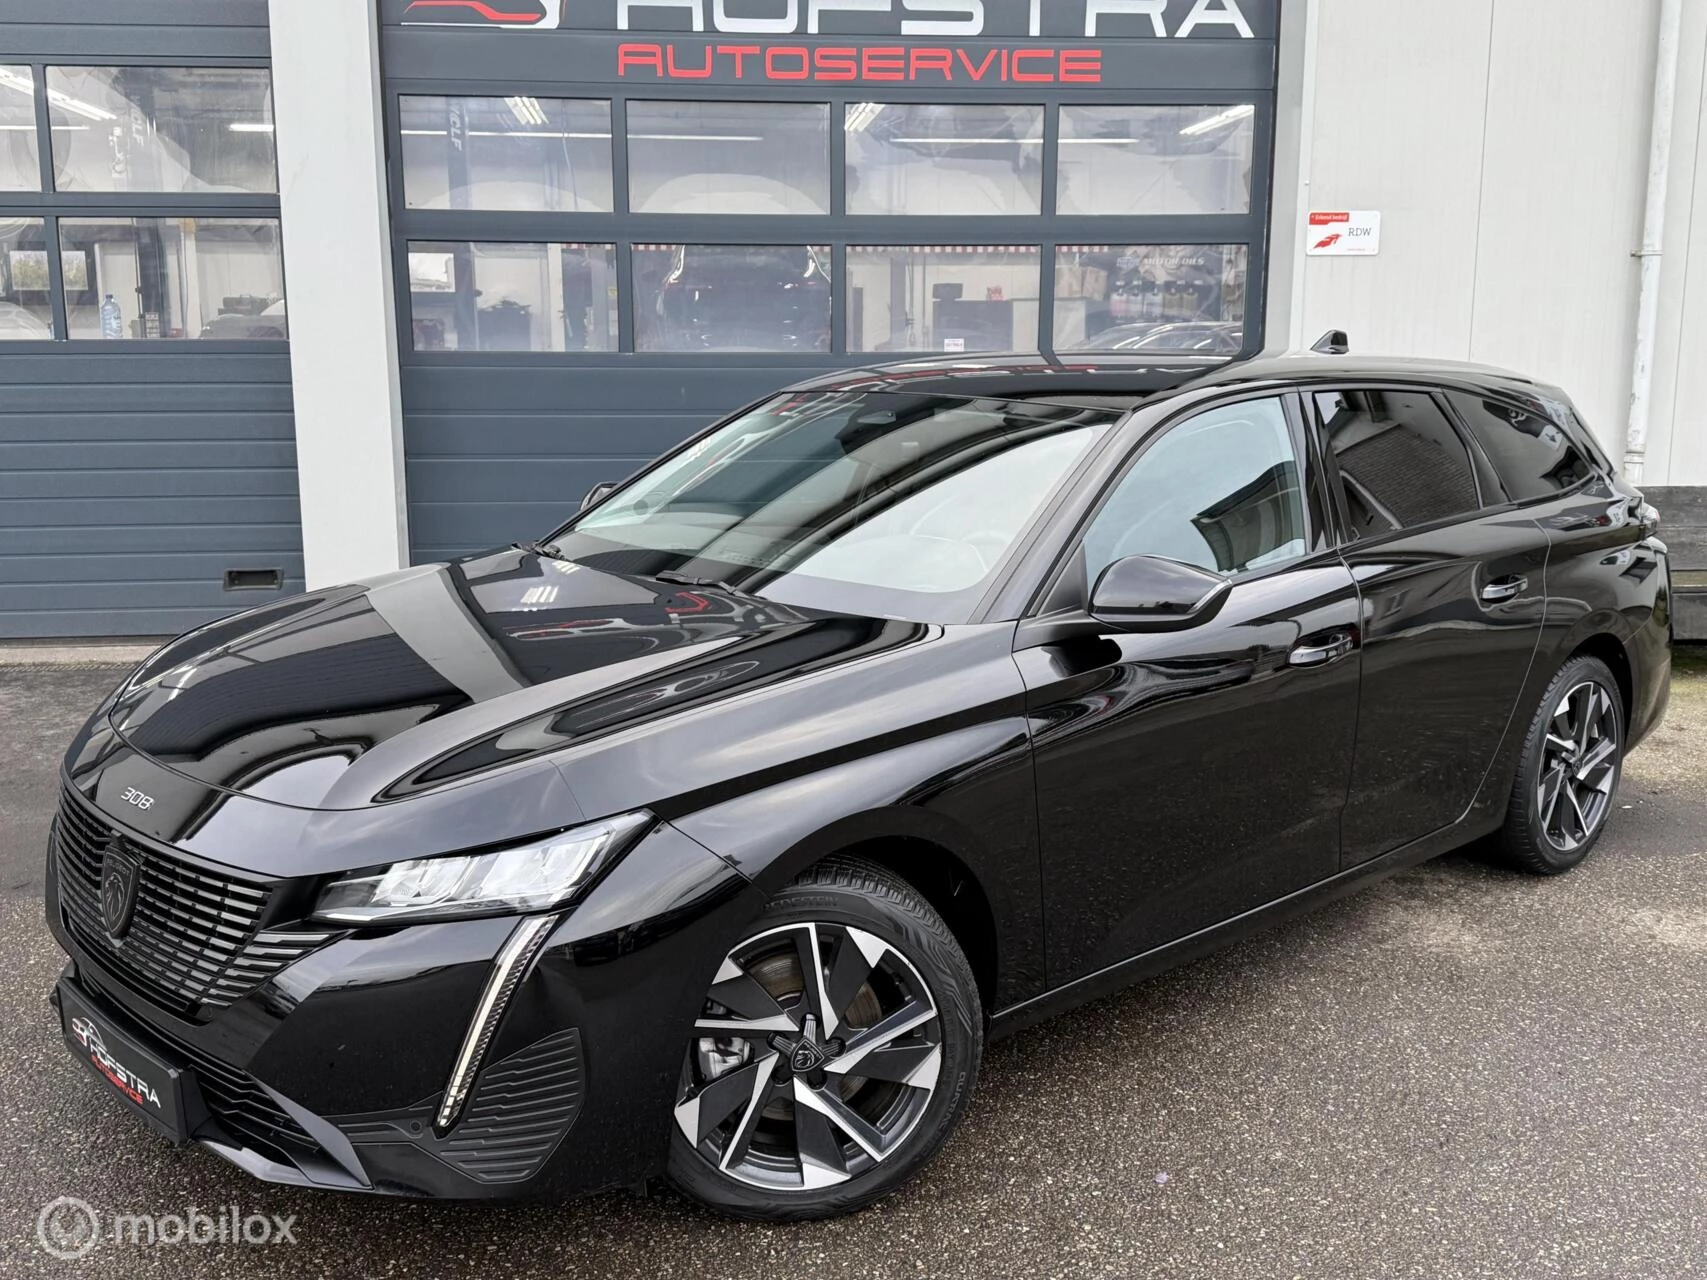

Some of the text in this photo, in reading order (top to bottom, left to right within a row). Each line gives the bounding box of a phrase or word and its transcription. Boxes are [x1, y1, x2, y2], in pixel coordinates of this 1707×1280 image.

[618, 44, 1103, 82] AUTOSERVICE
[1348, 227, 1372, 237] RDW
[120, 786, 154, 809] 308
[89, 1036, 161, 1108] HOFSTRA
